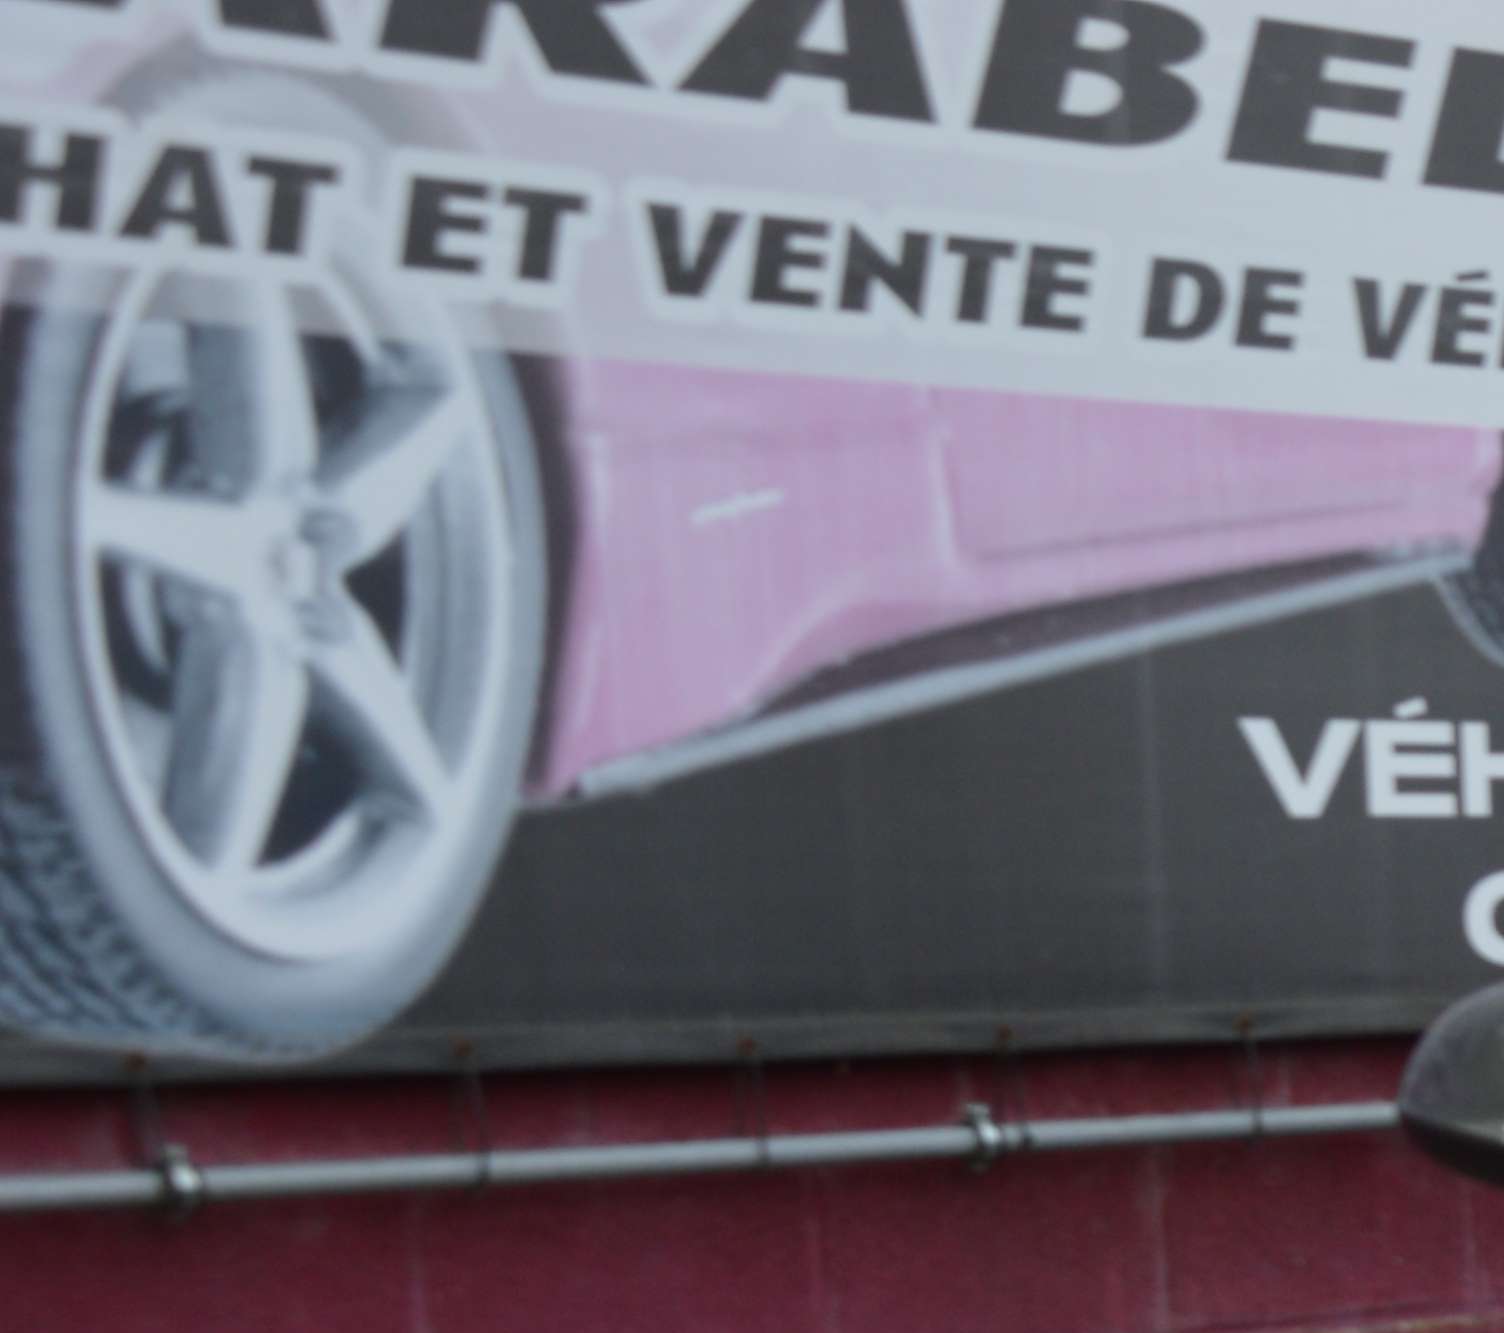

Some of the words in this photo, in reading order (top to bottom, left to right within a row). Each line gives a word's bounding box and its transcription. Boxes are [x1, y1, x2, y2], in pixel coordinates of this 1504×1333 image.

[401, 175, 589, 284] ET
[646, 202, 1094, 332] VENTE
[1141, 256, 1304, 351] DE
